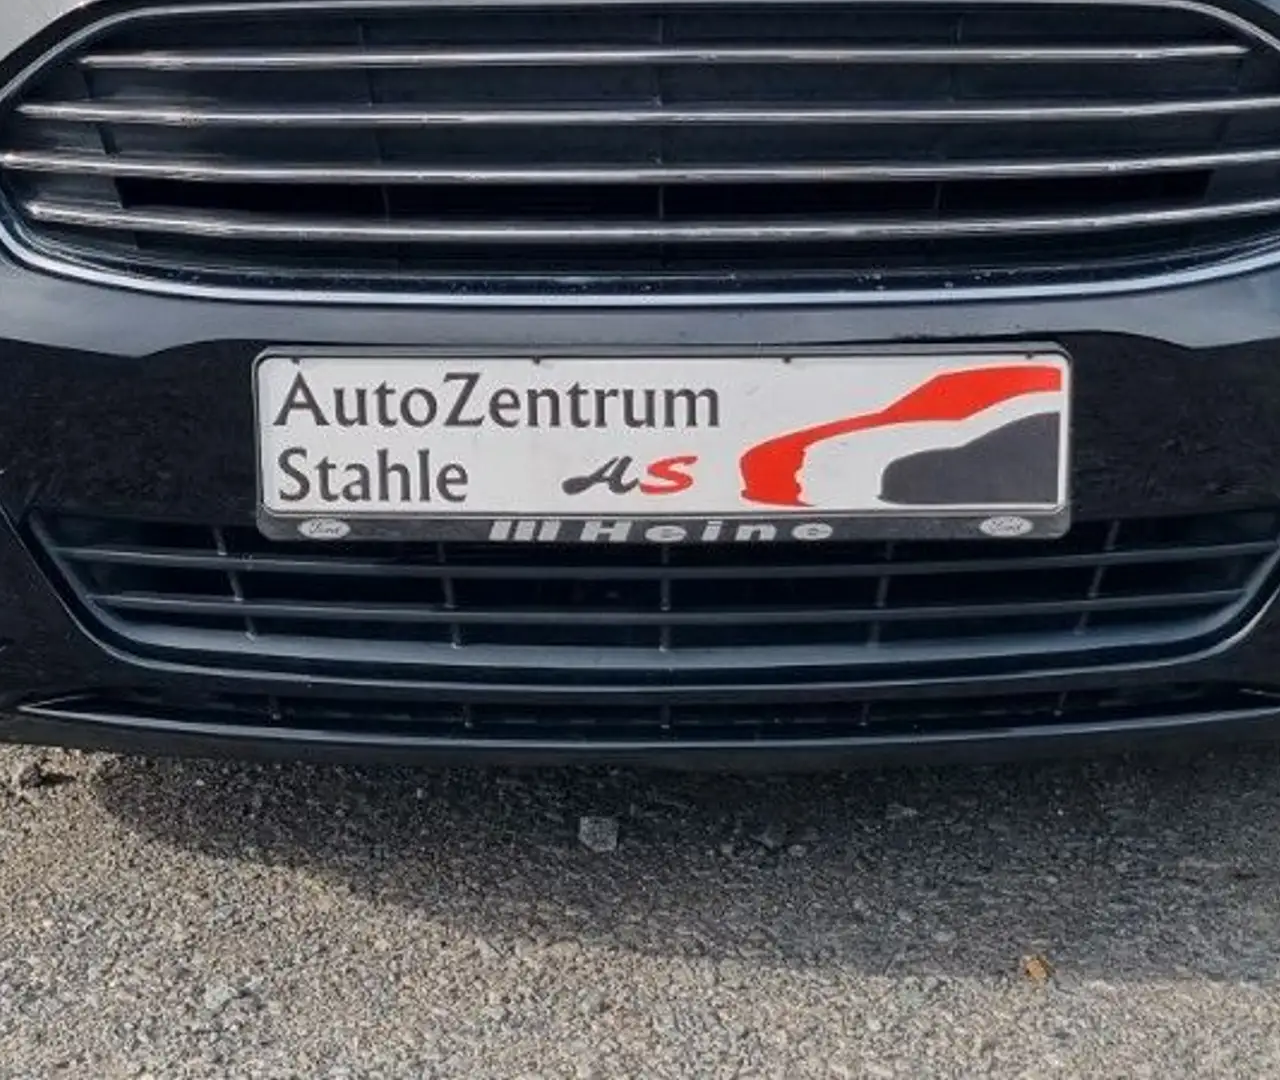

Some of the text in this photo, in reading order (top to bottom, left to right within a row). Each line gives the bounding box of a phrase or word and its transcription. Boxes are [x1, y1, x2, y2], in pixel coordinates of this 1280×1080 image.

[272, 371, 720, 428] AutoZentrum
[277, 446, 699, 503] Stahle AS
[578, 520, 834, 543] Heine
